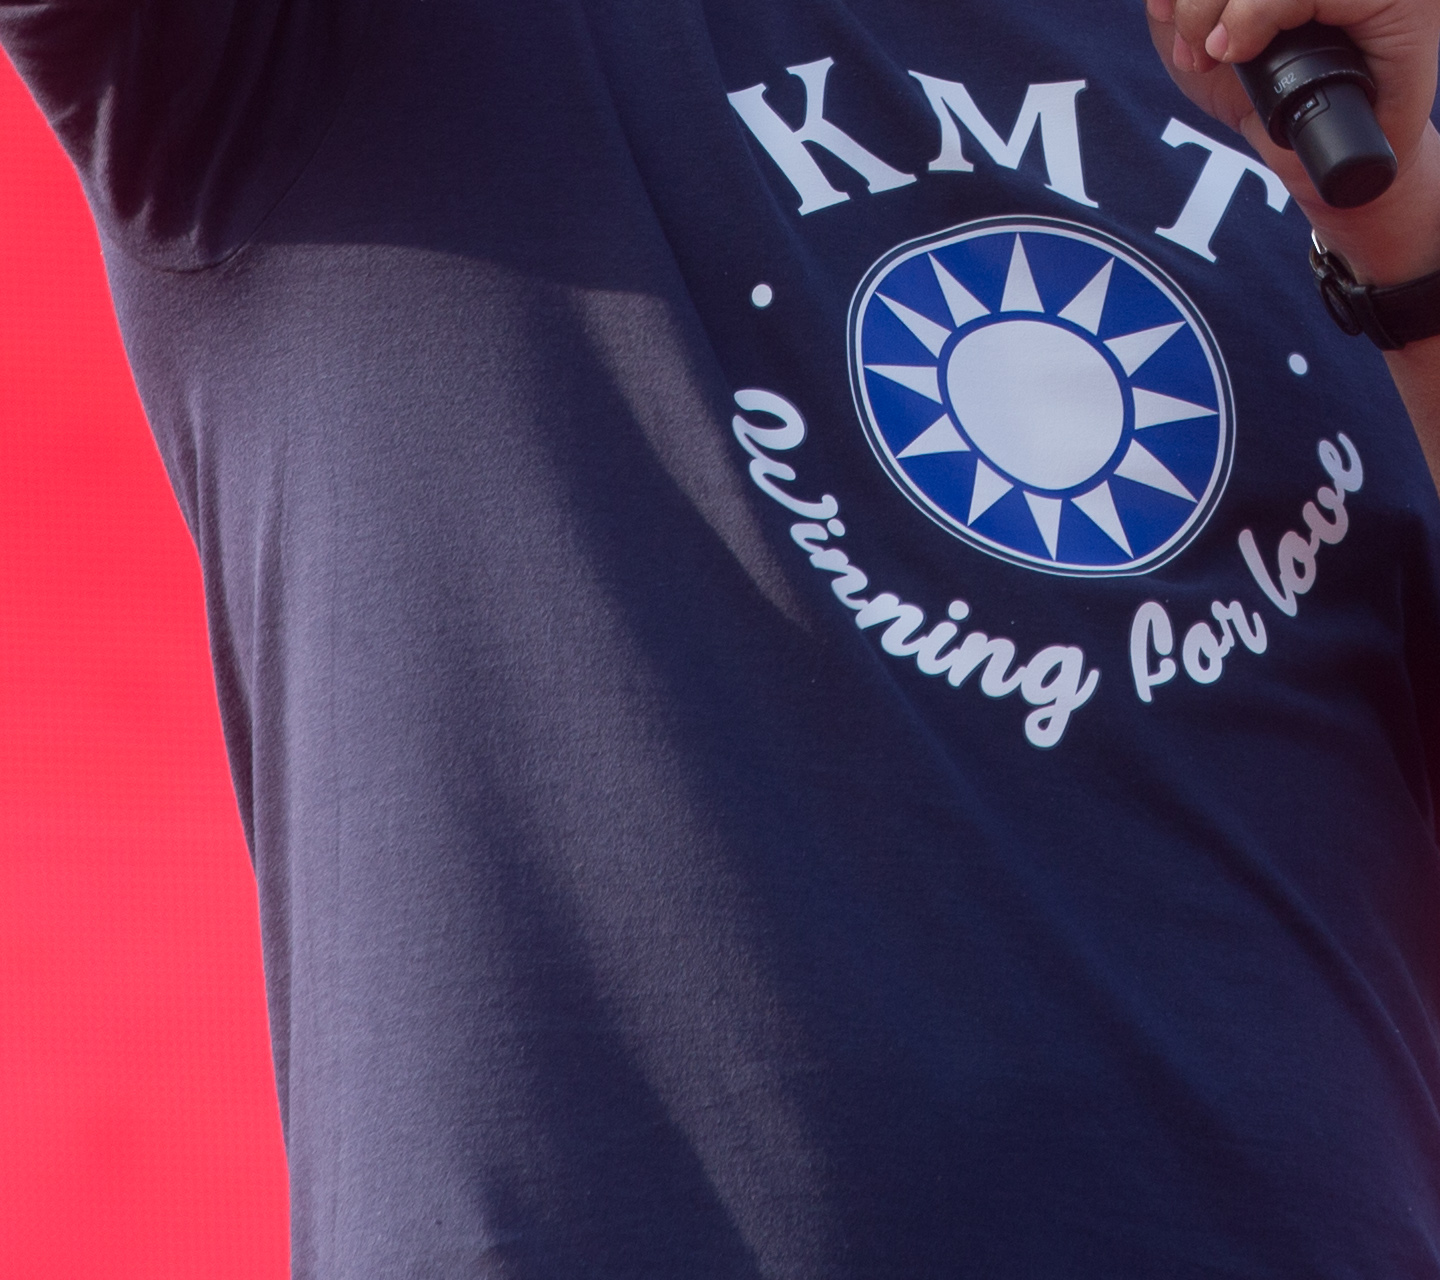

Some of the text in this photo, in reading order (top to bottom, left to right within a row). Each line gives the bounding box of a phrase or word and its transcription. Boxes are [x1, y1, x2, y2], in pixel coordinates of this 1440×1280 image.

[728, 57, 1290, 263] KMT
[1273, 72, 1297, 94] UR2
[1238, 432, 1364, 617] love
